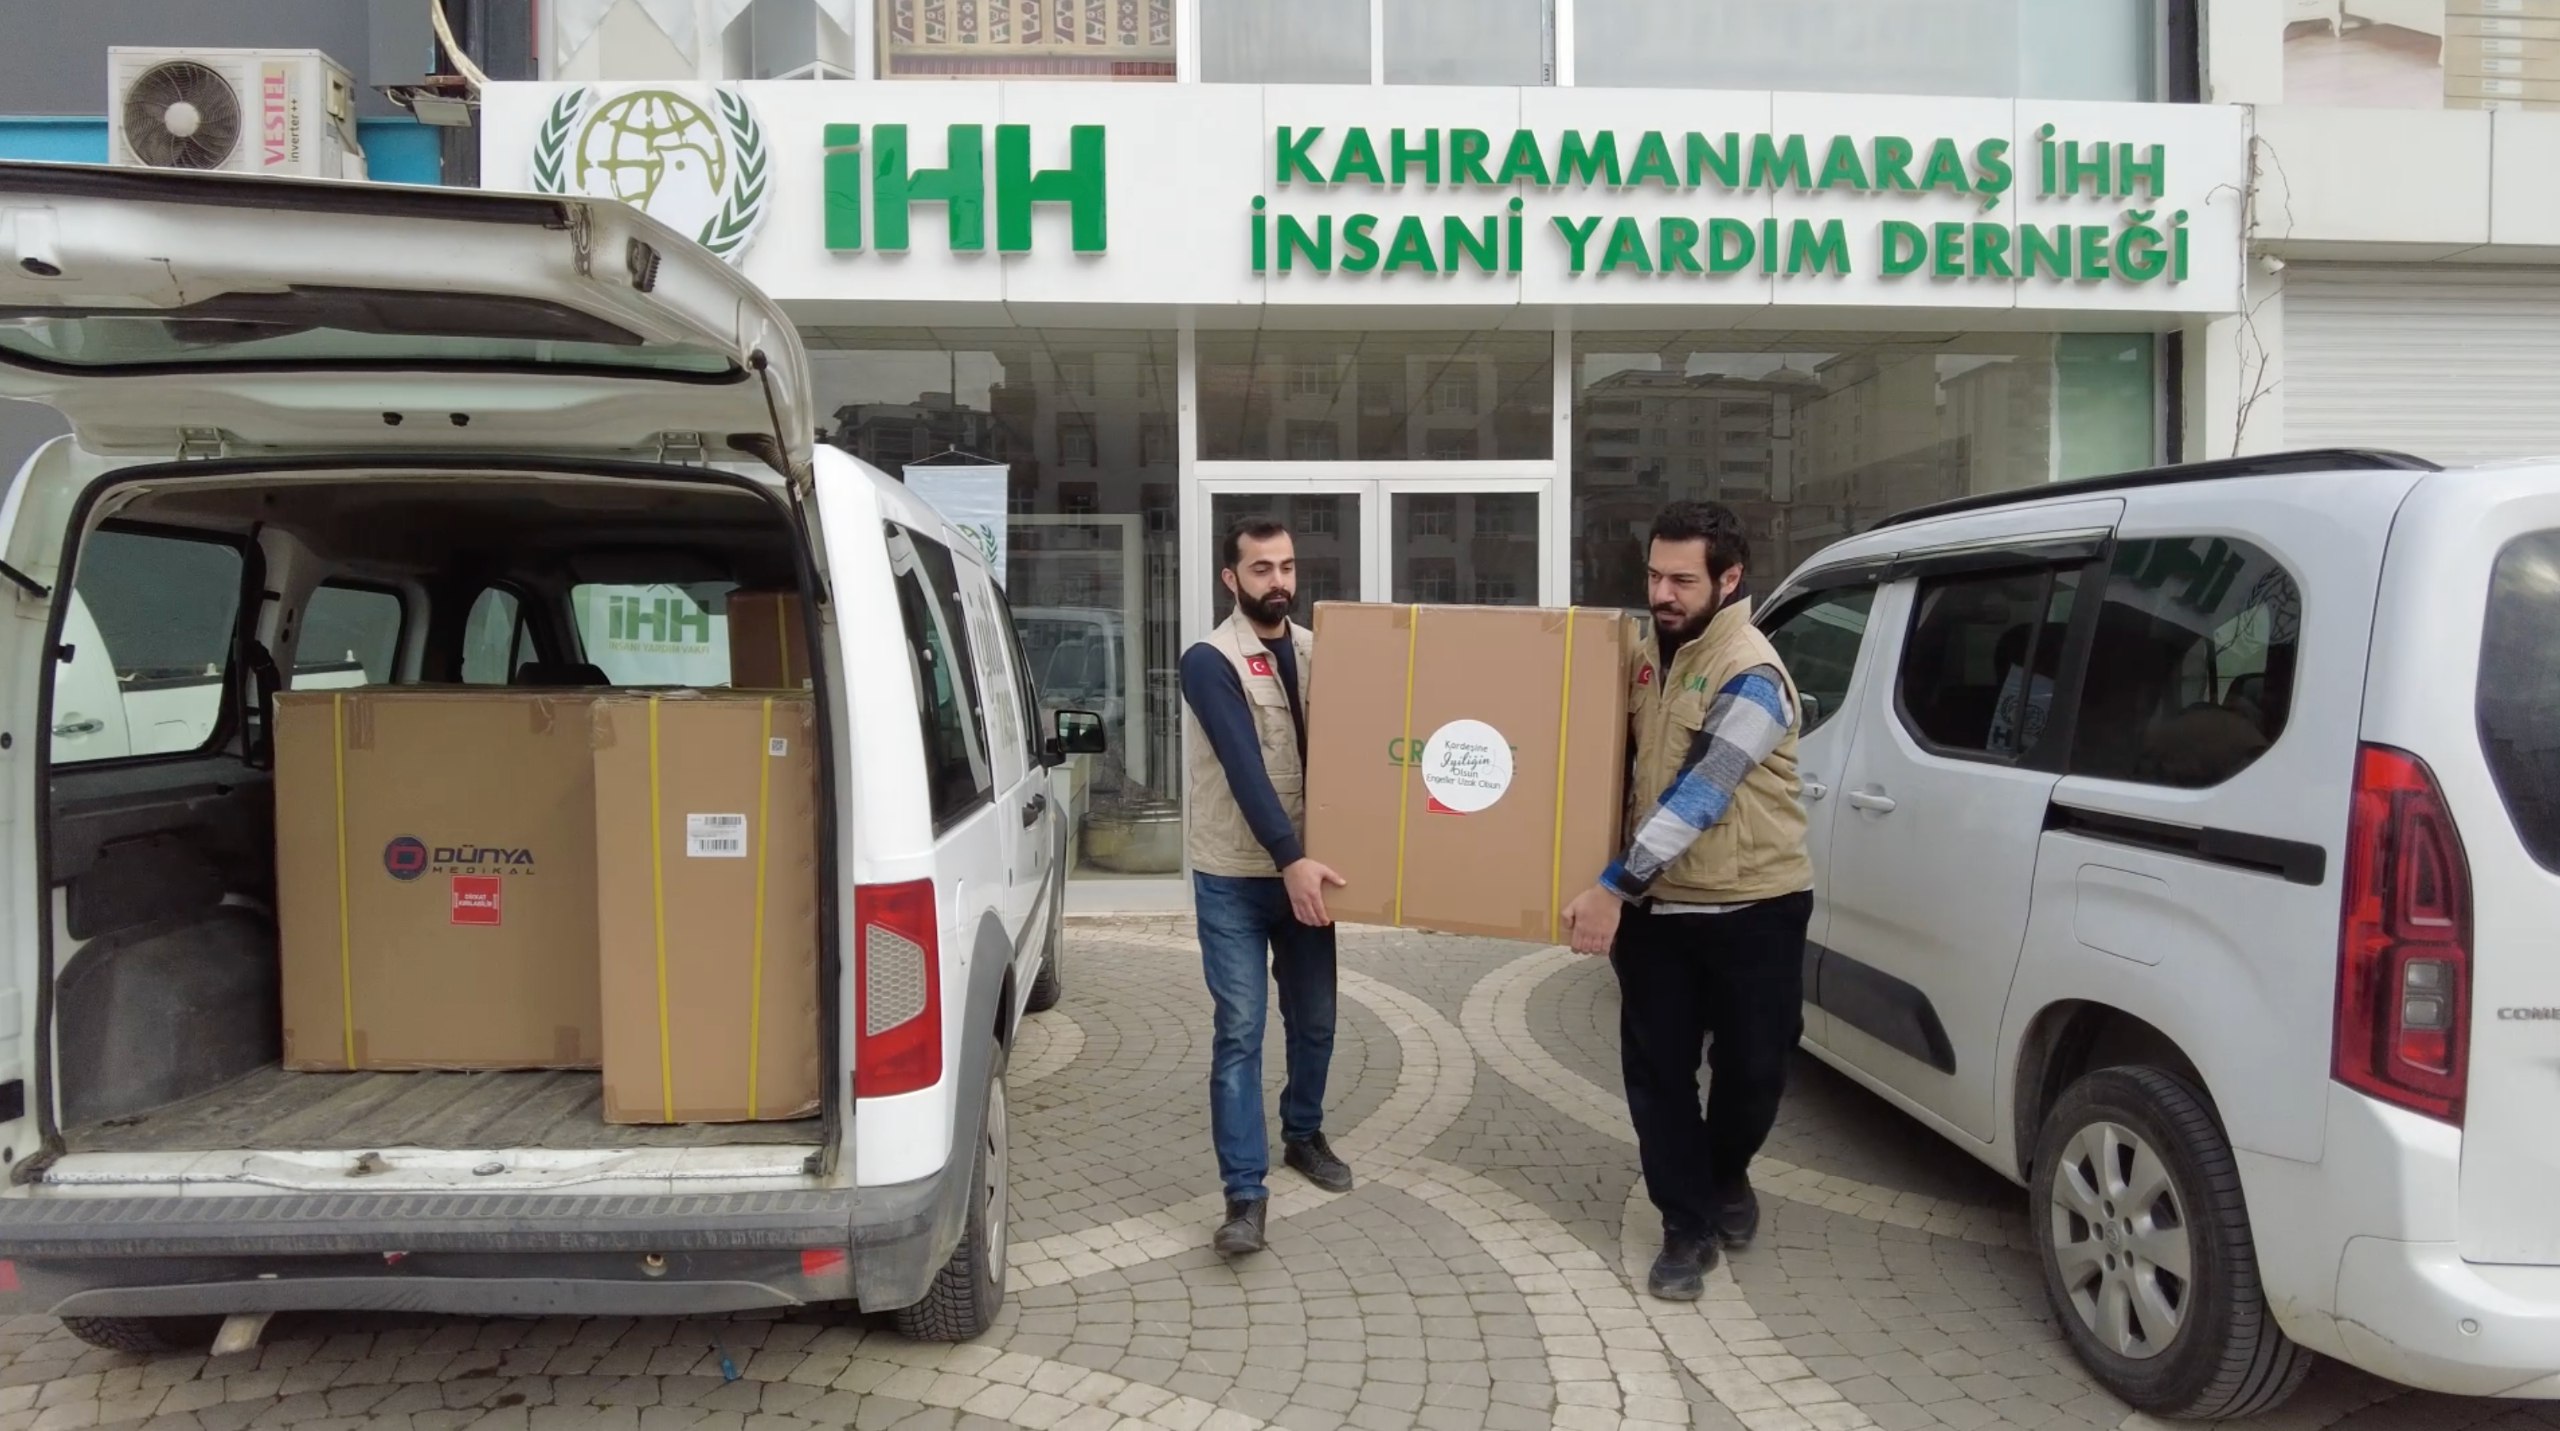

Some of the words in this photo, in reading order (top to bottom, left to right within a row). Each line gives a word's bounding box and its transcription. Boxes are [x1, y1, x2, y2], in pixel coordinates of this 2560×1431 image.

[263, 70, 285, 166] VESTEL
[824, 123, 1108, 254] İHH
[1276, 126, 2013, 214] KAHRAMANMARAŞ
[2041, 124, 2166, 198] İHH
[1251, 195, 1524, 274] İNSANİ
[1553, 216, 1852, 276] YARDIM
[1881, 209, 2190, 283] DERNEĞİ
[608, 595, 710, 643] İHH
[1453, 767, 1479, 778] Olsun
[433, 844, 535, 865] DÜNYA
